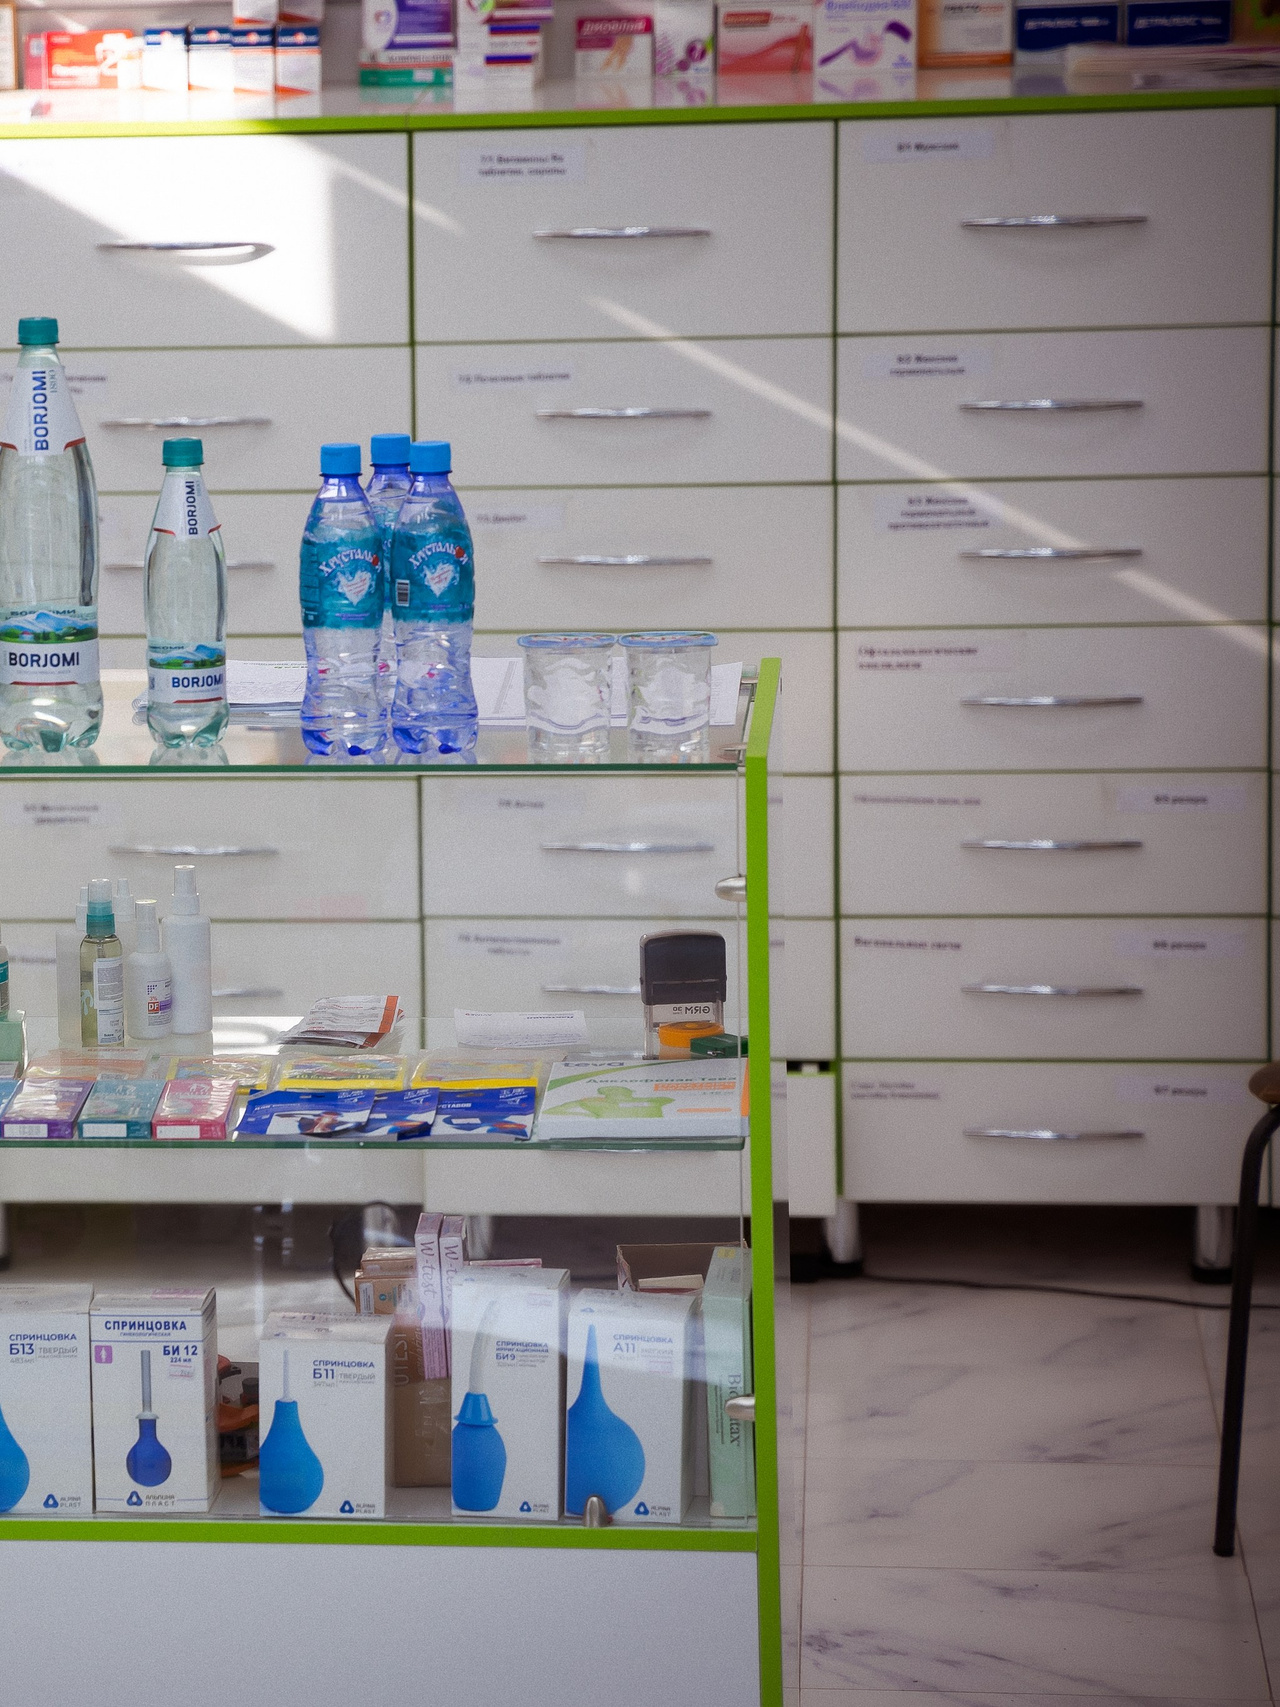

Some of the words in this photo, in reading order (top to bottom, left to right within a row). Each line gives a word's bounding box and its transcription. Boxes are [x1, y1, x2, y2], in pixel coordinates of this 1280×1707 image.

[49, 369, 58, 393] 1890
[32, 370, 49, 451] BORJOMI
[185, 481, 198, 535] BORJOMI
[9, 652, 79, 667] BORJOMI
[148, 1003, 160, 1011] DF
[420, 1240, 435, 1300] W-test
[104, 1320, 187, 1332] СПРИНЦОВКА
[9, 1333, 77, 1342] СПРИНЦОВКА
[613, 1333, 673, 1343] СПРИНЦОВКА
[9, 1343, 34, 1355] Б13
[38, 1346, 78, 1354] ТВЕРДЫЙ
[163, 1345, 180, 1355] БИ
[184, 1345, 198, 1355] 12
[496, 1340, 549, 1348] СПРИНЦОВКА
[613, 1343, 636, 1354] А11
[312, 1360, 375, 1368] СПРИНЦОВКА
[313, 1368, 335, 1379] Б11
[339, 1373, 376, 1381] ТВЕРДЫЙ
